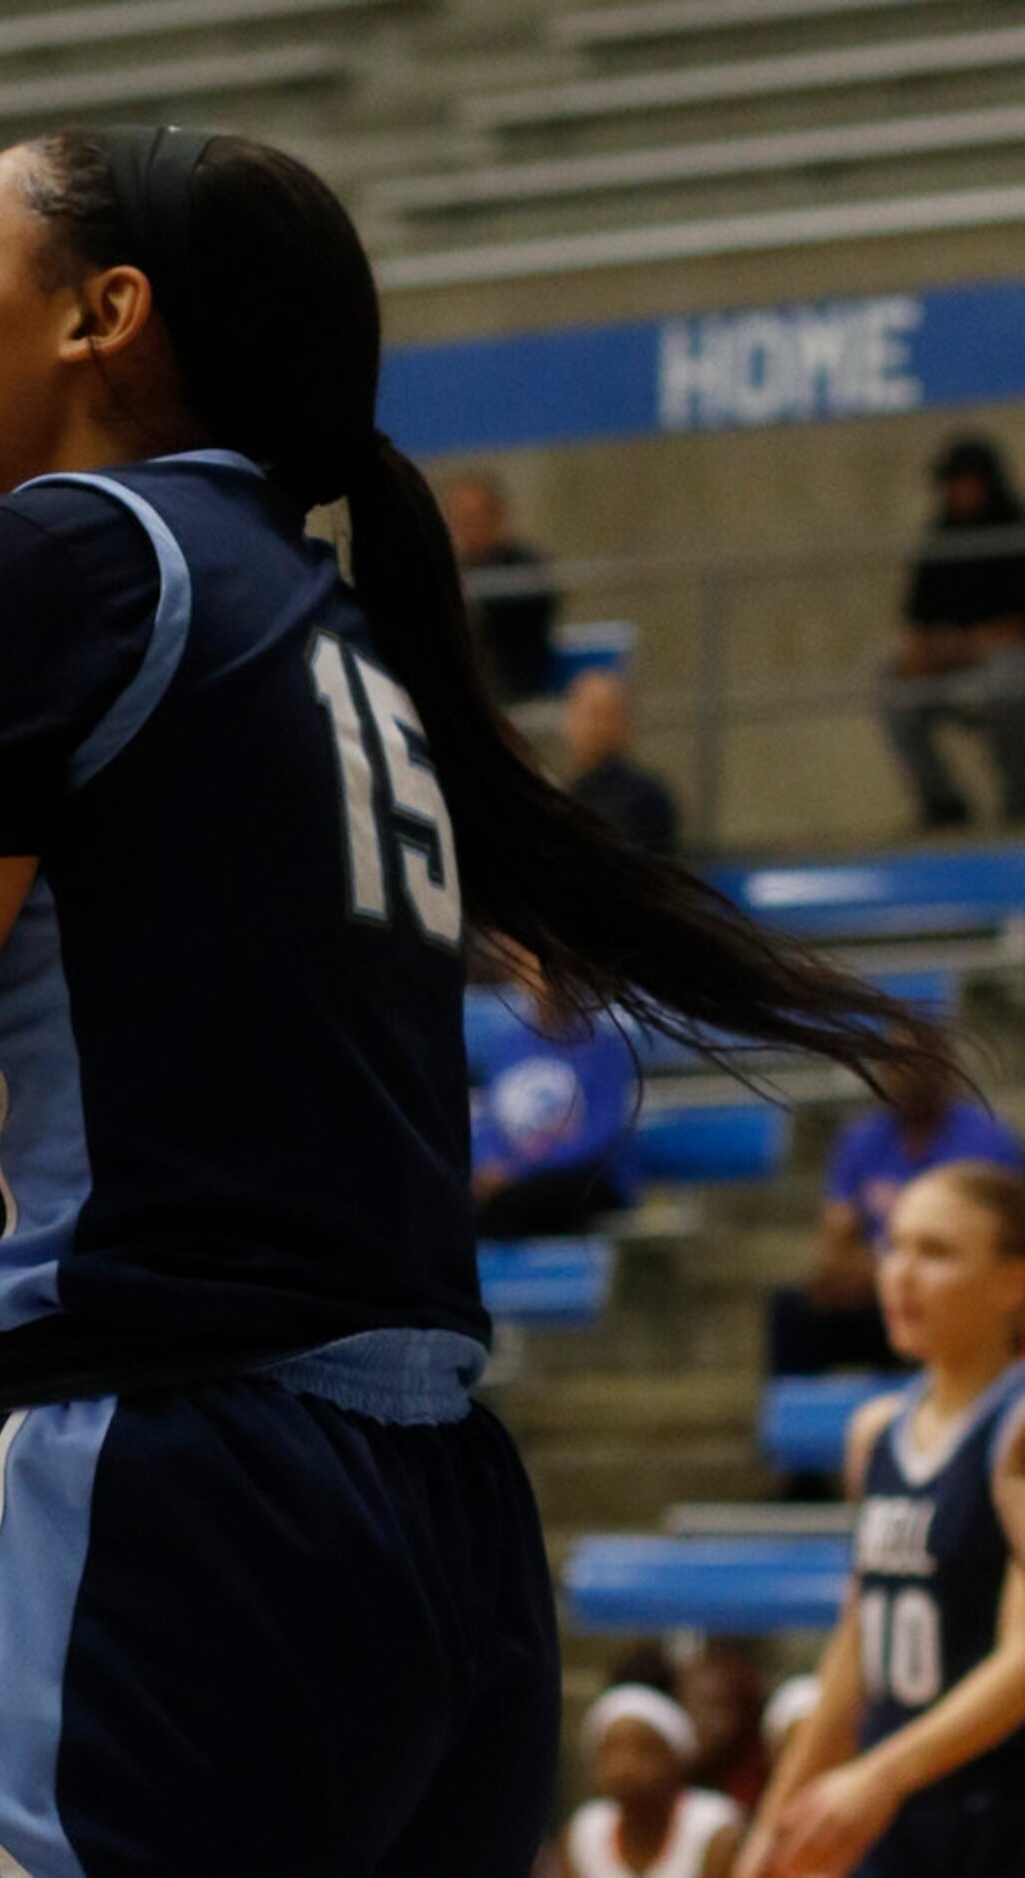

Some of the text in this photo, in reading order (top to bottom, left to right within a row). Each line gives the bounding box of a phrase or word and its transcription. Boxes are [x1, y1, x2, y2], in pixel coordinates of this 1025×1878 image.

[660, 296, 923, 427] HOME
[308, 630, 463, 945] 15
[861, 1588, 942, 1706] 10
